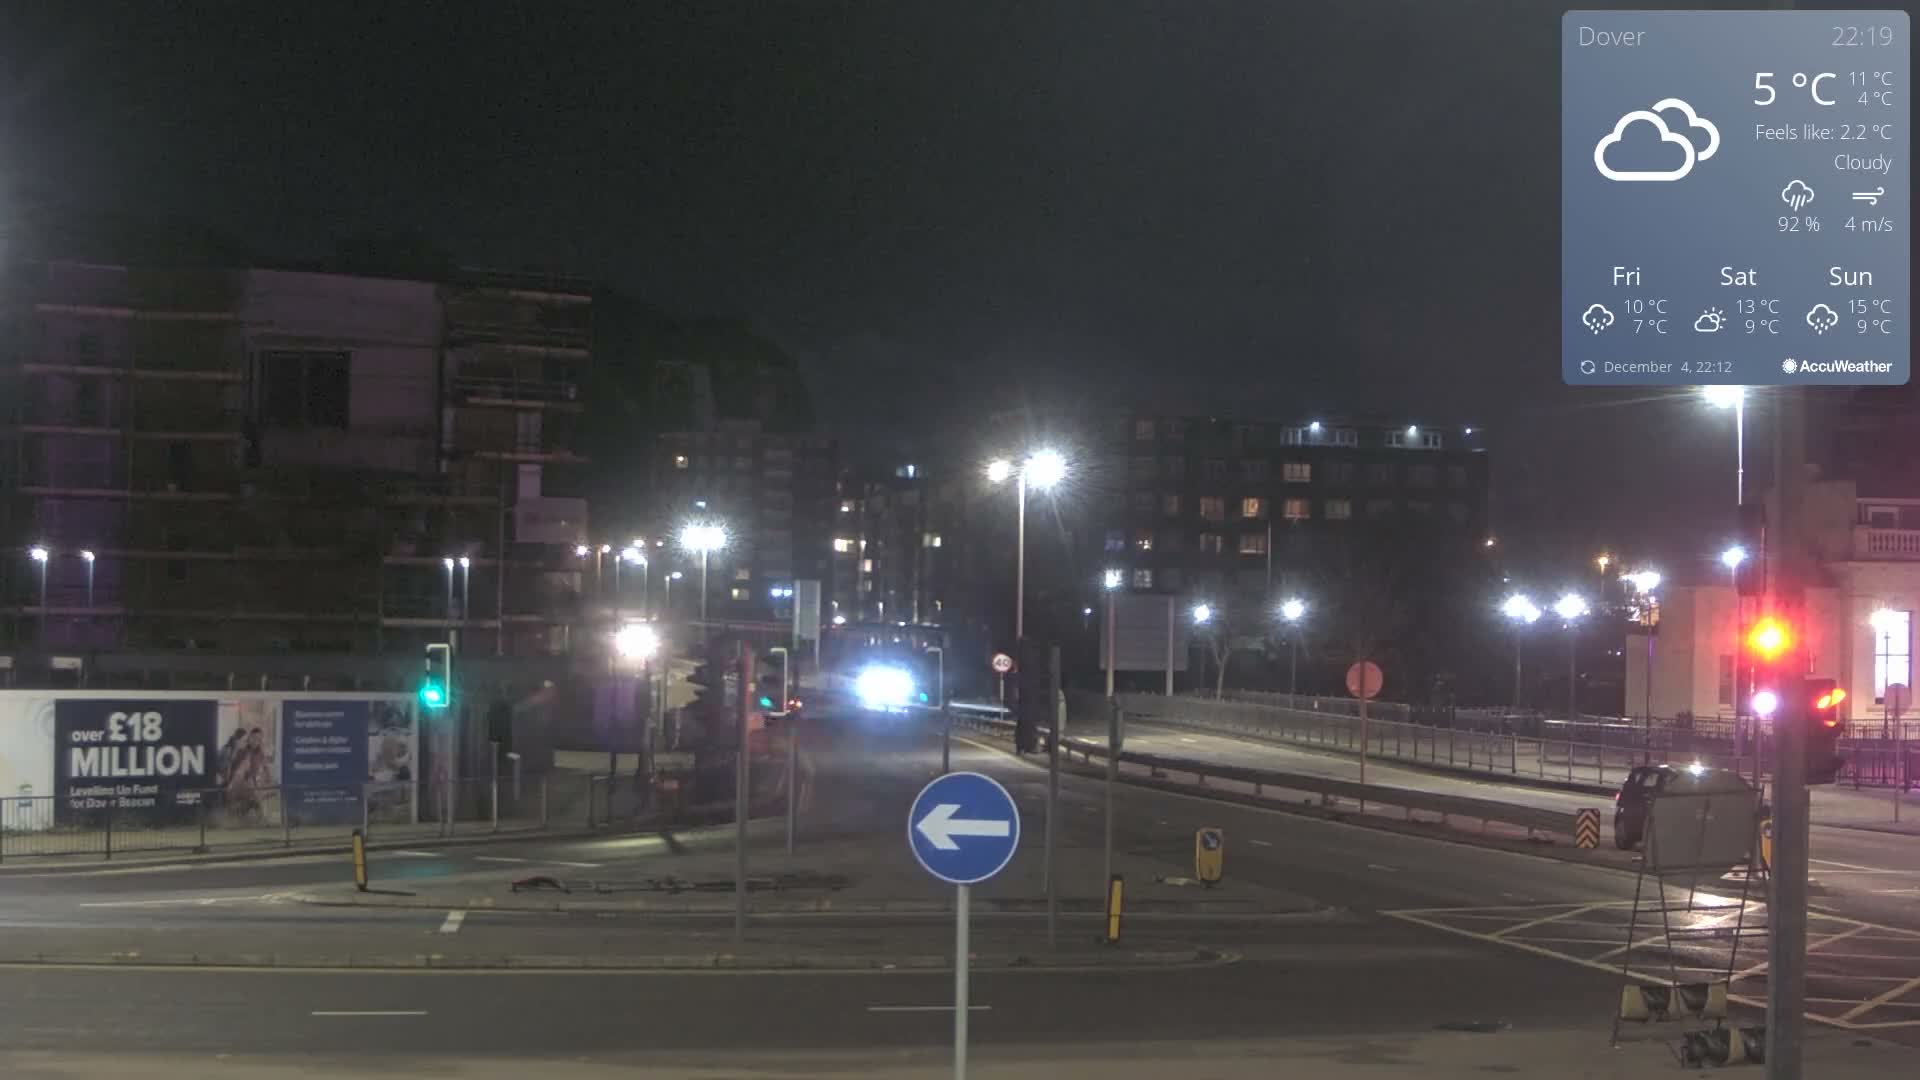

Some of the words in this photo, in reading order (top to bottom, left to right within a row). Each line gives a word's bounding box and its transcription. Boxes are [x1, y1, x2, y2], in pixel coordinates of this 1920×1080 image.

[995, 658, 1009, 667] 40
[72, 730, 104, 741] over
[109, 712, 162, 741] £18
[72, 745, 205, 777] MILLION
[133, 785, 158, 795] Fund
[86, 799, 116, 808] Dovr
